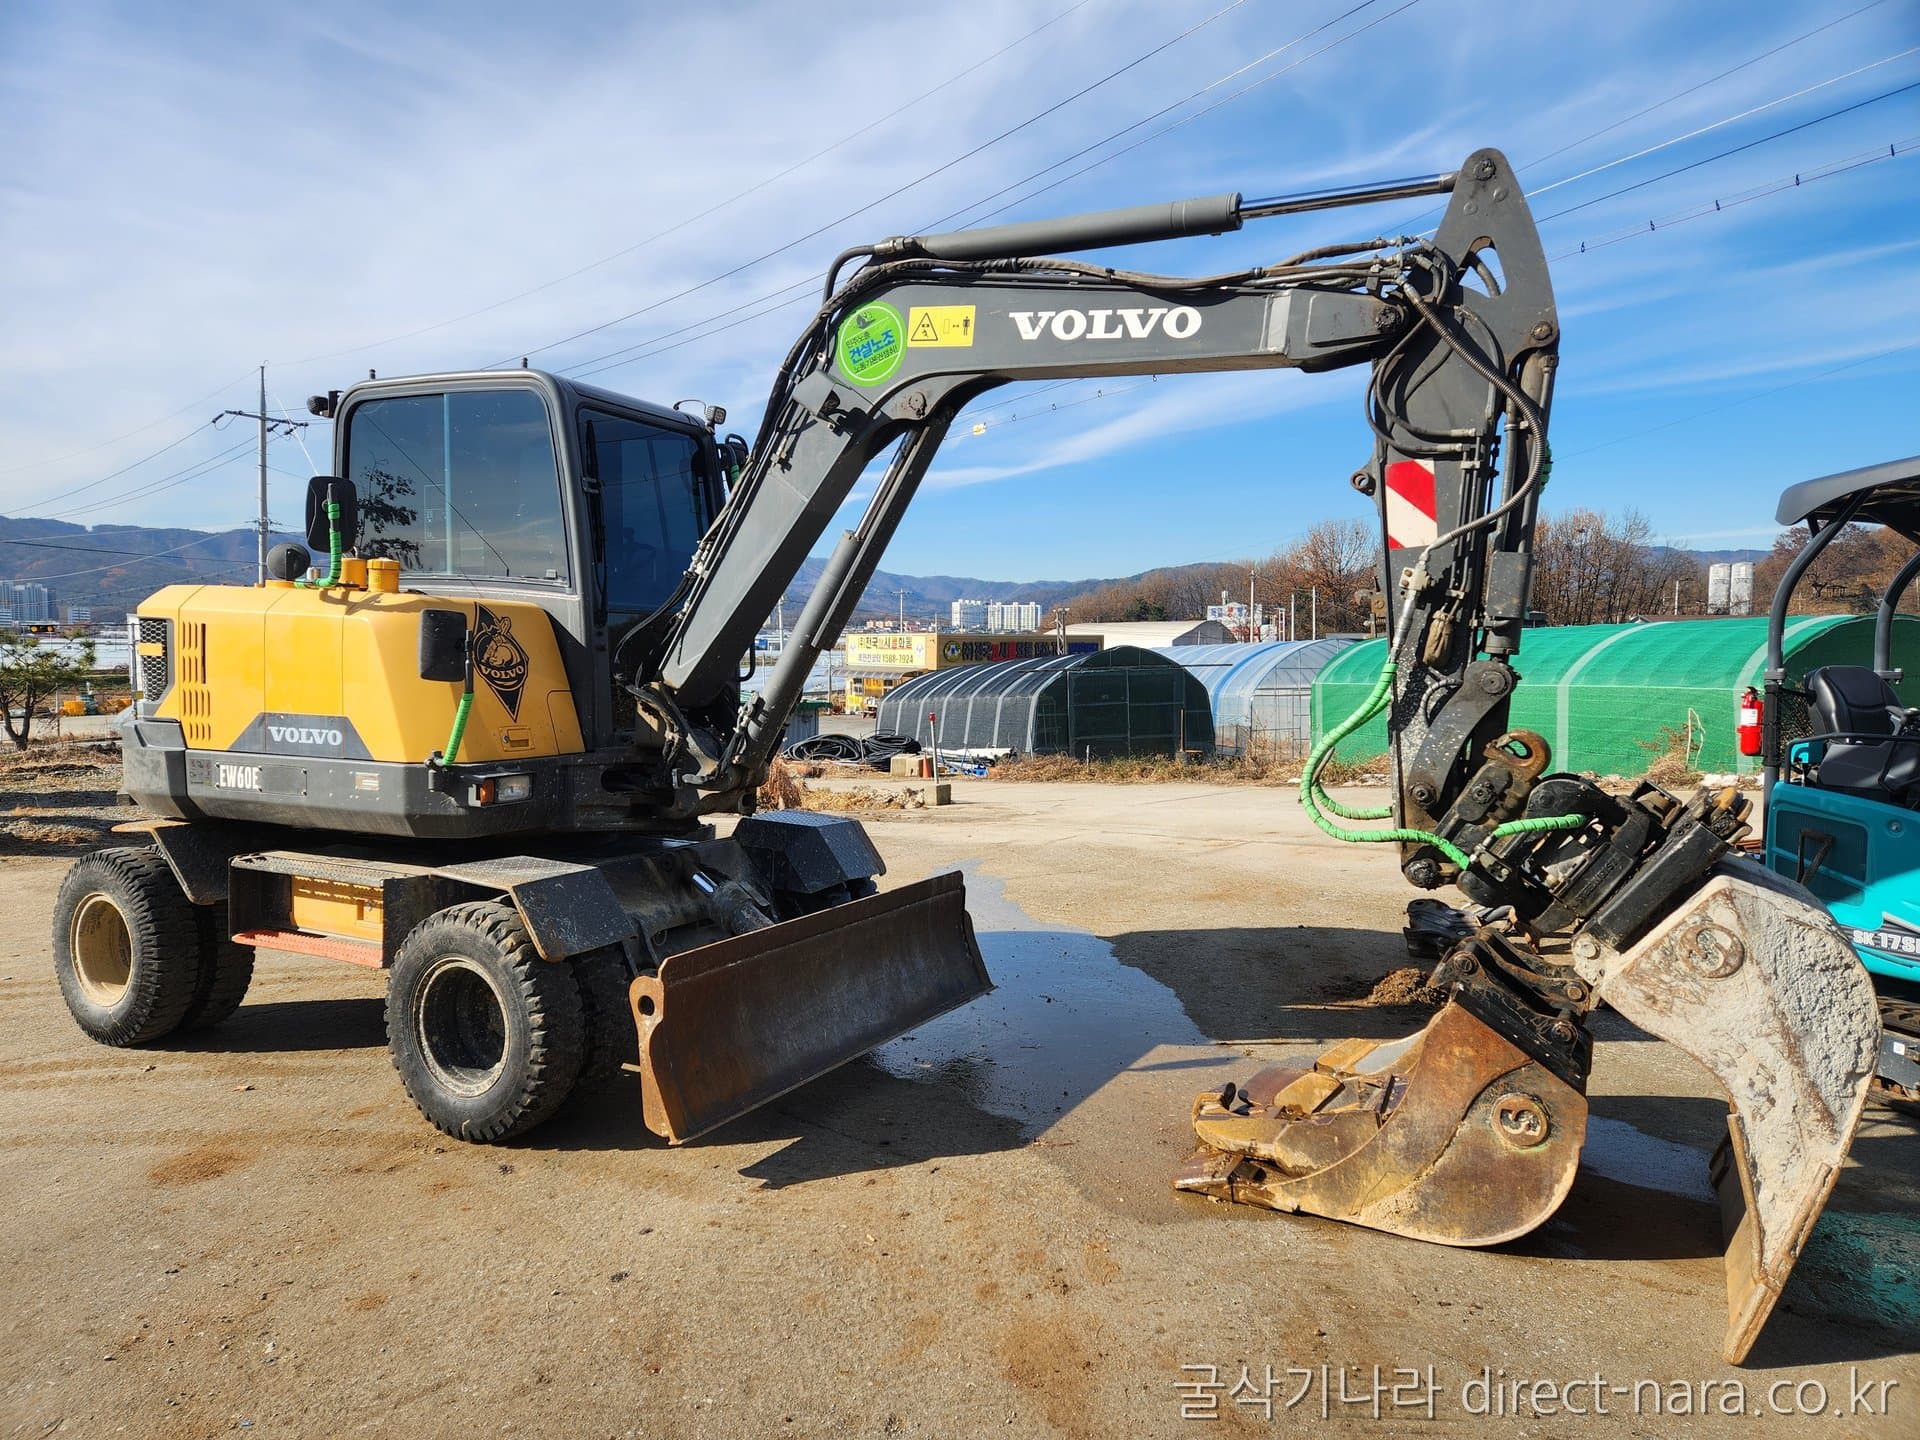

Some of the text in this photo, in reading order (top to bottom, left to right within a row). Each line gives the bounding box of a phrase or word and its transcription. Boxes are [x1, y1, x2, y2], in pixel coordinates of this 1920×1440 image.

[1009, 306, 1203, 341] VOLVO
[849, 328, 896, 365] 건설노조
[479, 663, 525, 679] VOLVO
[267, 726, 343, 746] VOLVO
[219, 764, 259, 790] EW60E
[1853, 930, 1875, 946] SK
